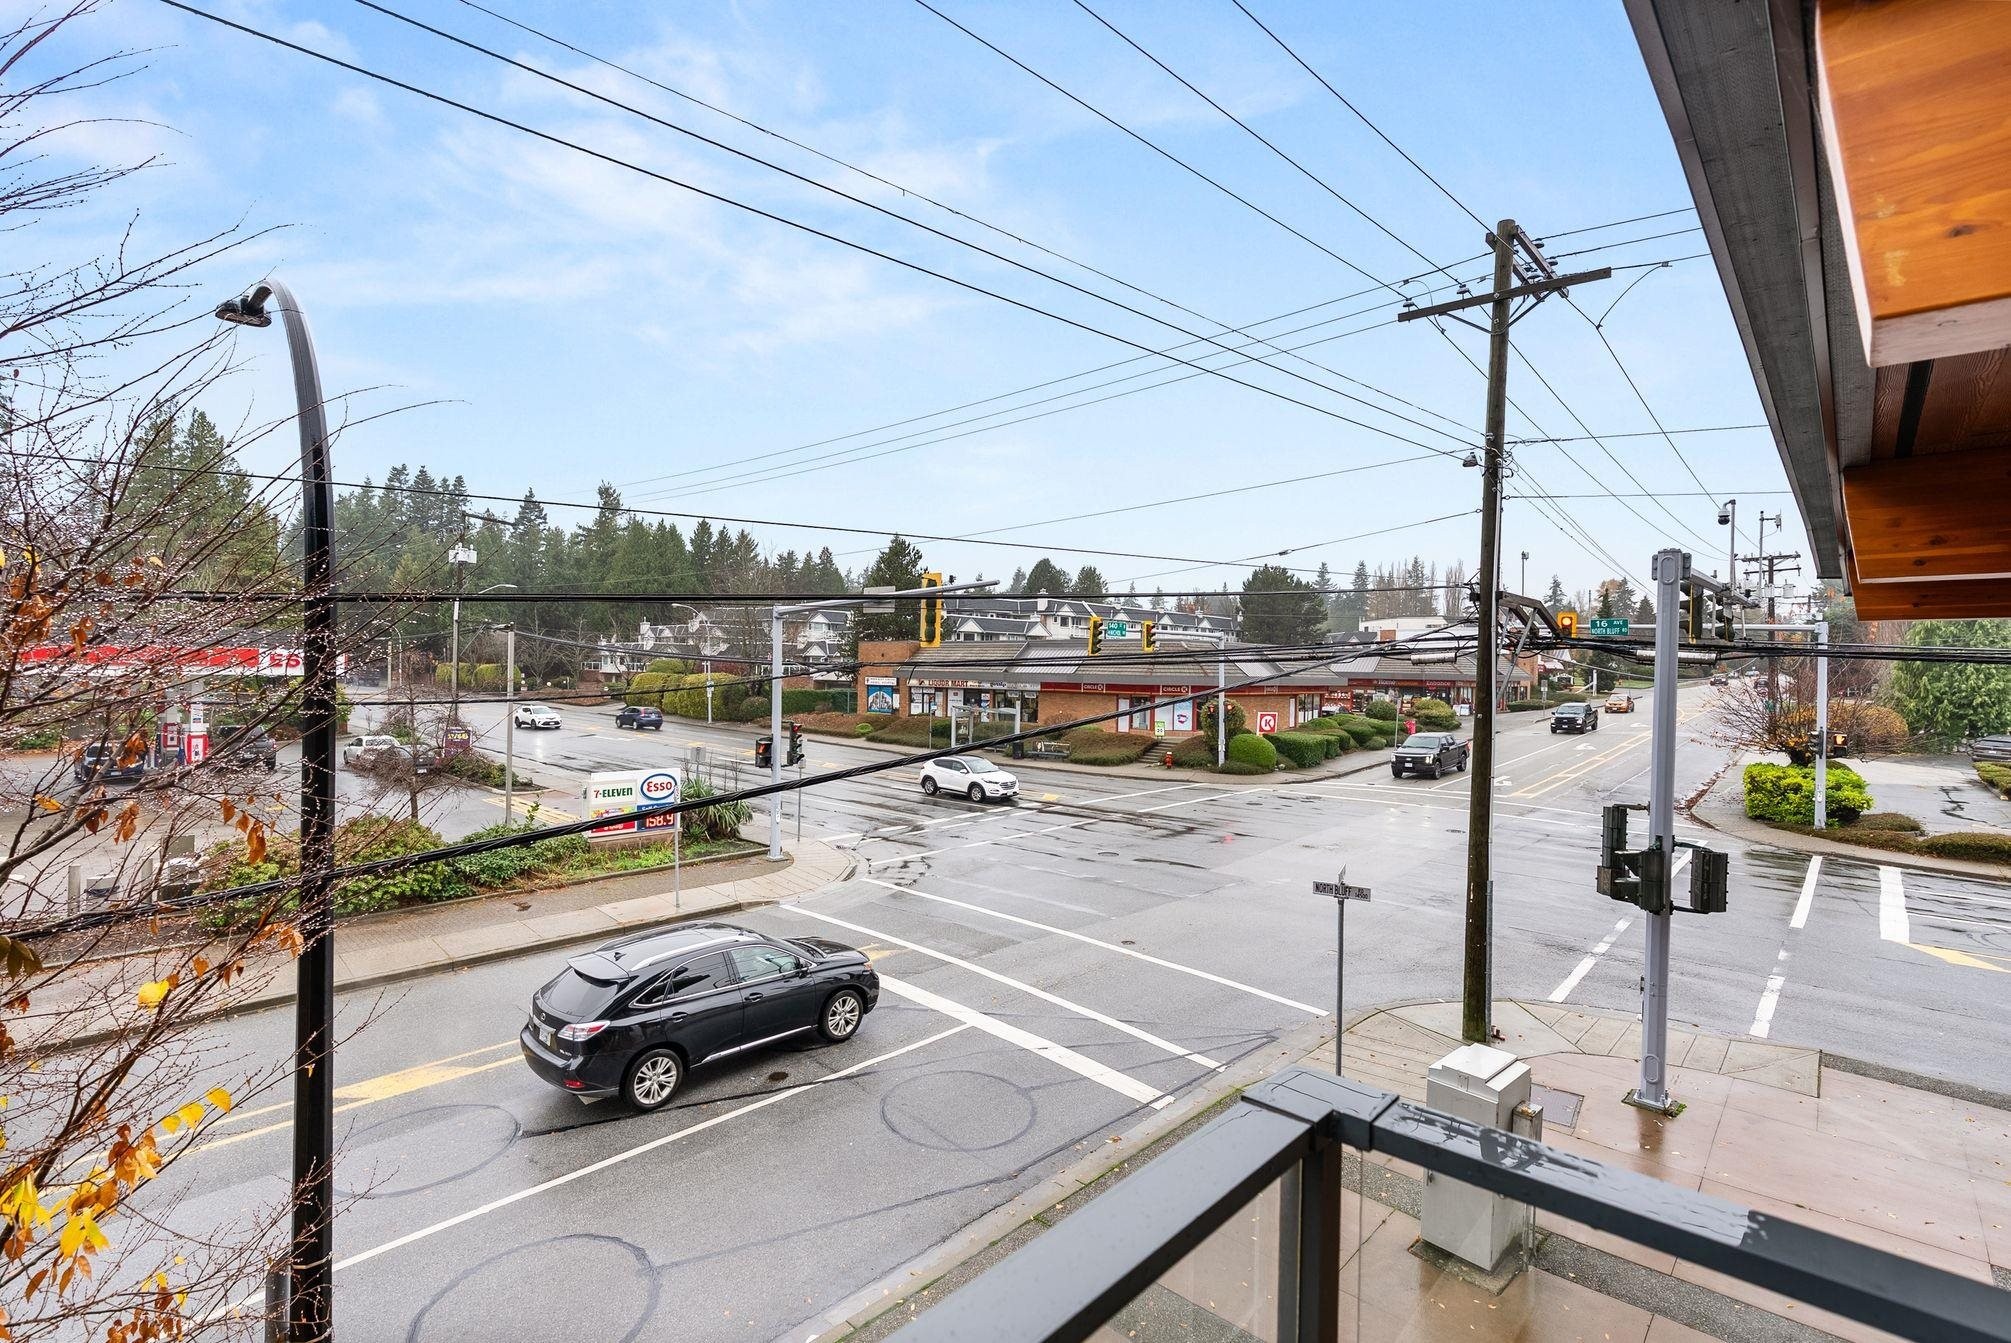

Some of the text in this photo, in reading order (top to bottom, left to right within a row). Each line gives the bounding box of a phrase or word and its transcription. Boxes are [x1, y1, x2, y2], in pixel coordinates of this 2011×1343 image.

[928, 679, 950, 687] LIQUOR
[951, 680, 969, 688] MART
[1264, 718, 1272, 728] K
[1314, 882, 1334, 895] NORTH
[1334, 884, 1352, 897] BLUFF
